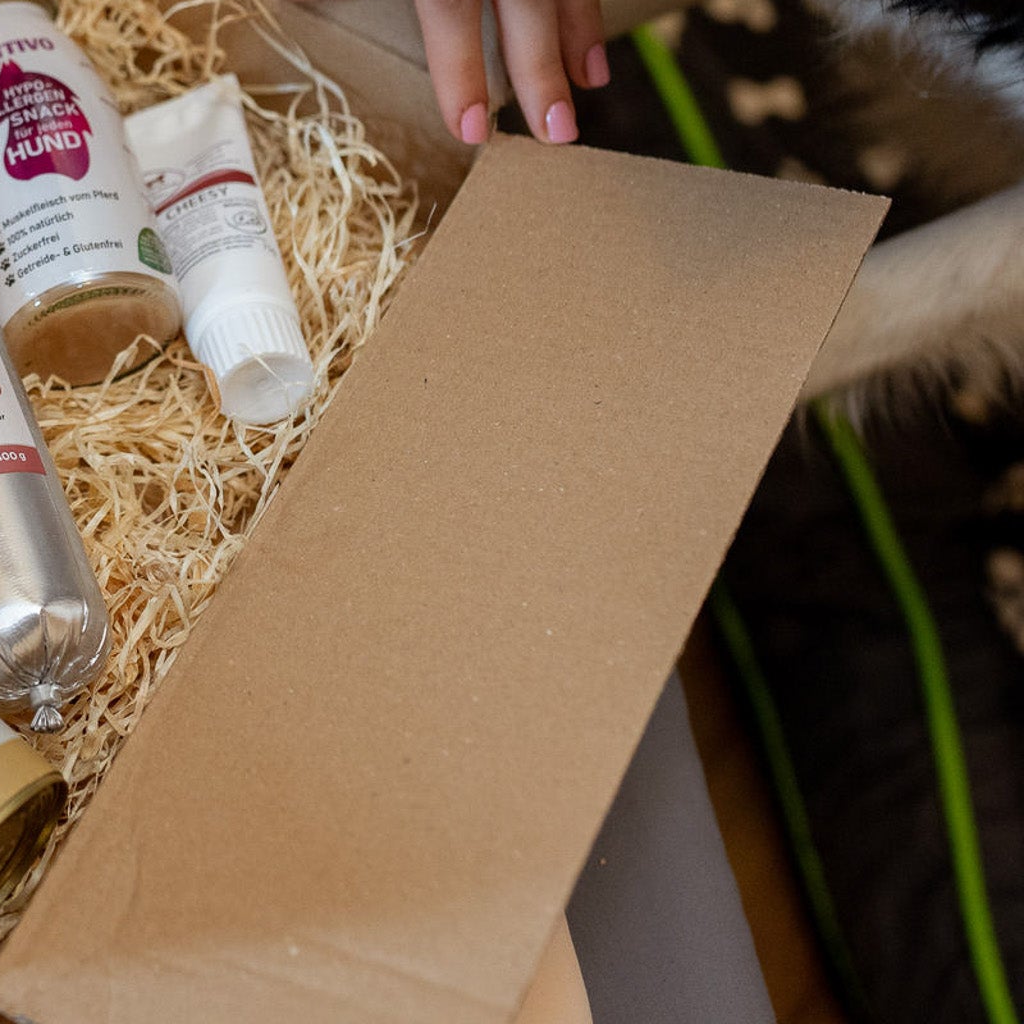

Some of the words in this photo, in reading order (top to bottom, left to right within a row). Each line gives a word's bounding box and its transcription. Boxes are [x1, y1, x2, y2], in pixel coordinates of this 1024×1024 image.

[3, 79, 53, 100] HYPO-
[9, 102, 79, 127] SNACK
[14, 126, 33, 140] für
[37, 119, 73, 136] jeden
[6, 130, 81, 166] HUND
[2, 195, 67, 228] Muskelfleisch
[69, 192, 91, 202] vom
[165, 187, 229, 221] CHEESY
[7, 228, 28, 246] 100%
[29, 212, 74, 234] natürlich
[12, 233, 60, 263] Zuckerfrei
[17, 253, 61, 279] Getreide-
[63, 247, 71, 257] &
[73, 240, 123, 253] Glutenfrei
[19, 453, 27, 462] g
